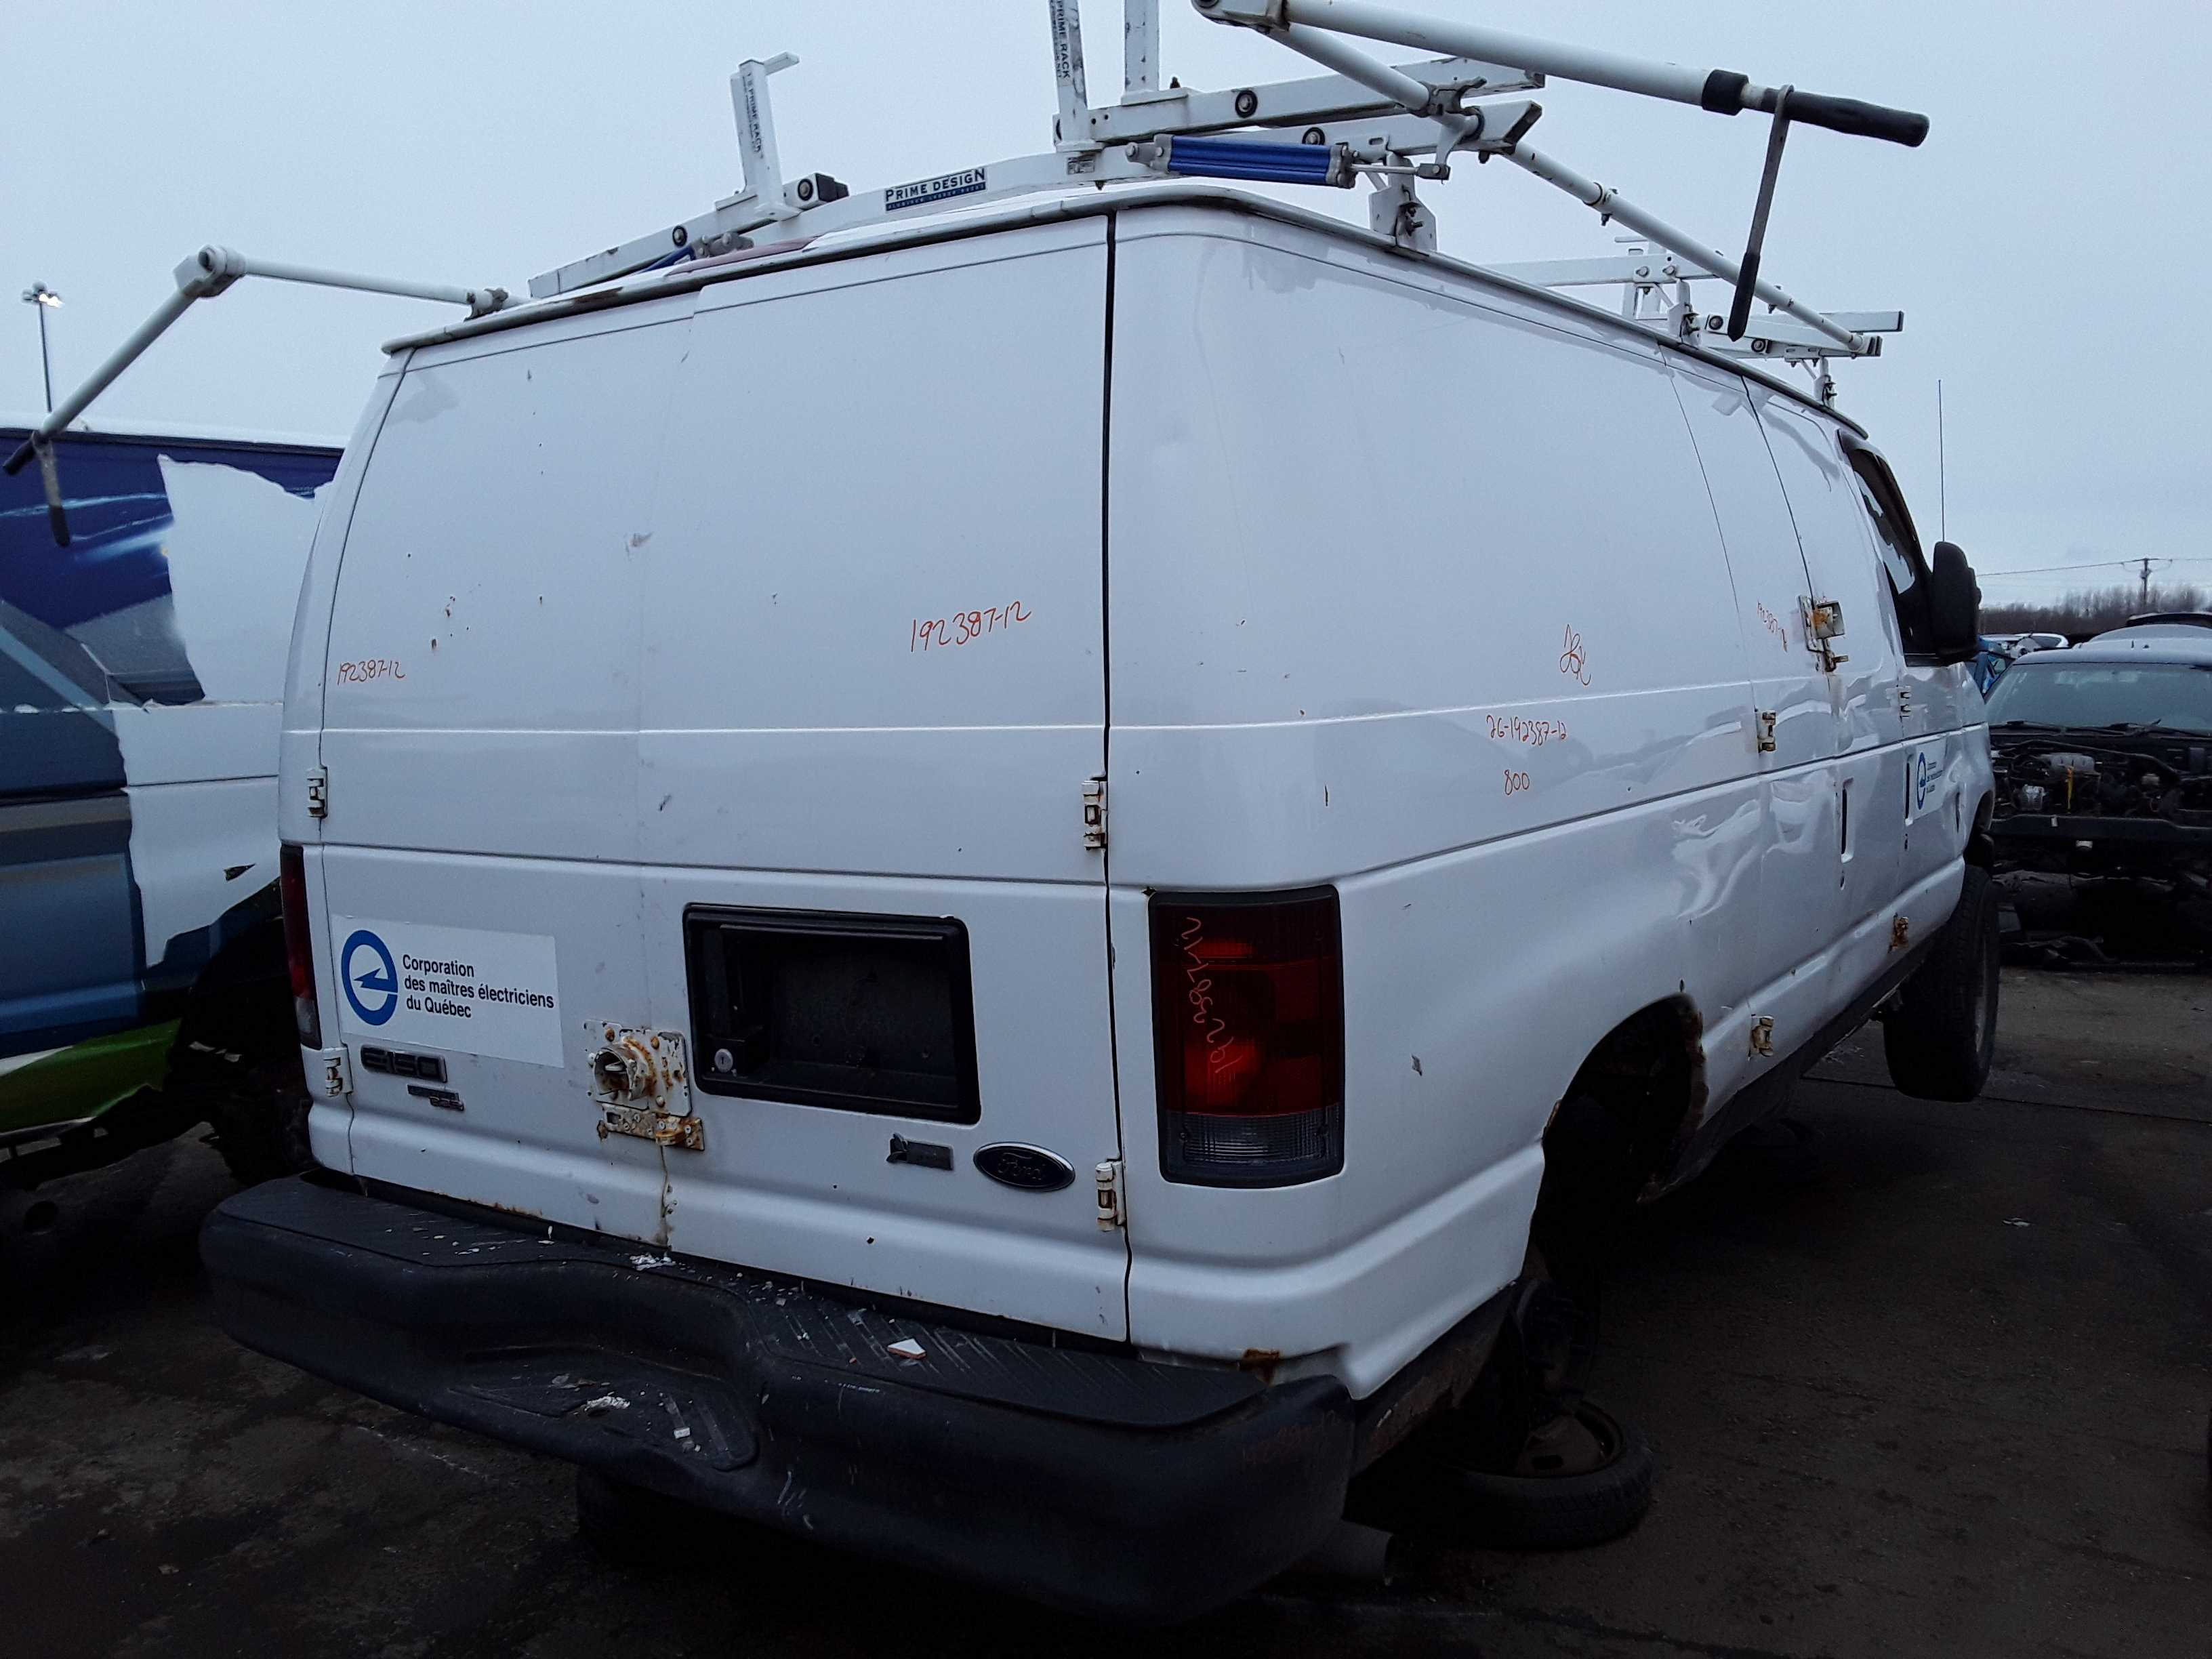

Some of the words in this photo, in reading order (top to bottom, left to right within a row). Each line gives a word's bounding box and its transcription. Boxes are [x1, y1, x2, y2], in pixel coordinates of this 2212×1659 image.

[1060, 43, 1071, 78] RACK
[1504, 769, 1530, 796] 800
[403, 954, 474, 977] Corporation
[404, 975, 426, 991] des
[429, 979, 474, 998] maîtres
[478, 983, 554, 1008] électriciens
[407, 995, 422, 1010] du
[424, 996, 472, 1018] Québec
